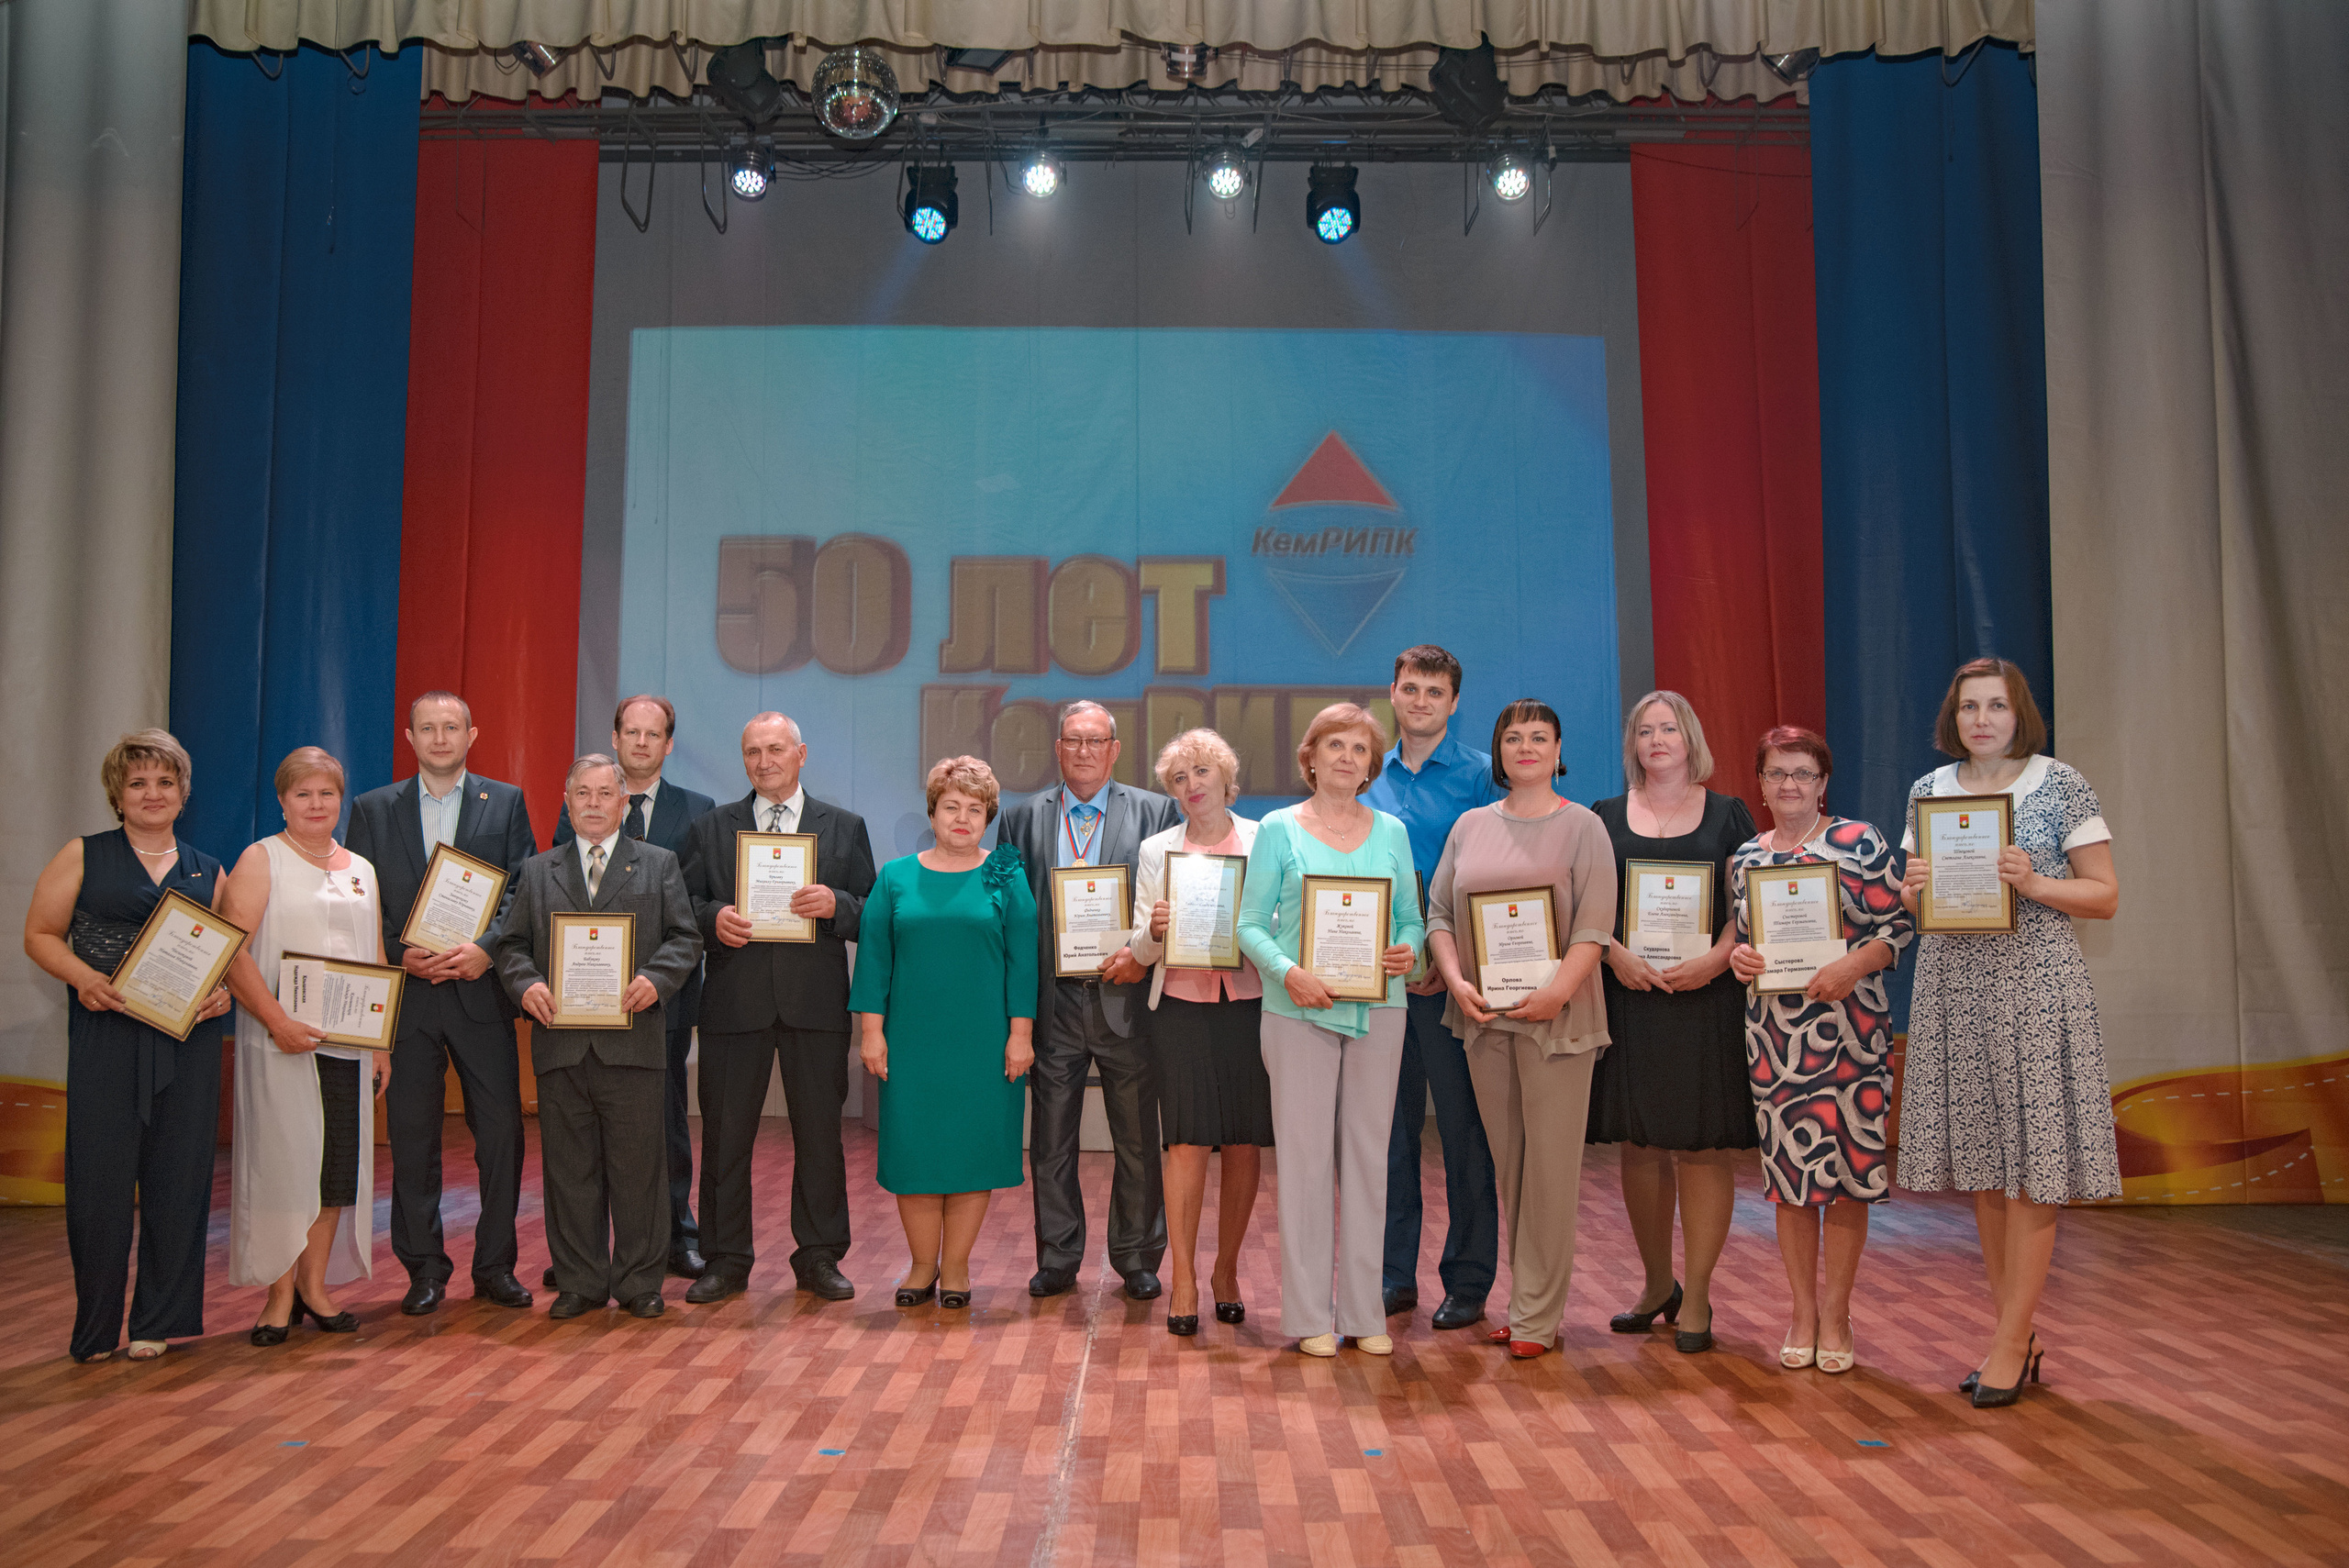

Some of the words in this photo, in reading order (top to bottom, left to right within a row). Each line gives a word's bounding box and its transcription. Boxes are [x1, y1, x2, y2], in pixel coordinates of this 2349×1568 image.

[1251, 526, 1419, 558] КемРИПК
[716, 532, 912, 676] 50
[940, 555, 1225, 676] лет
